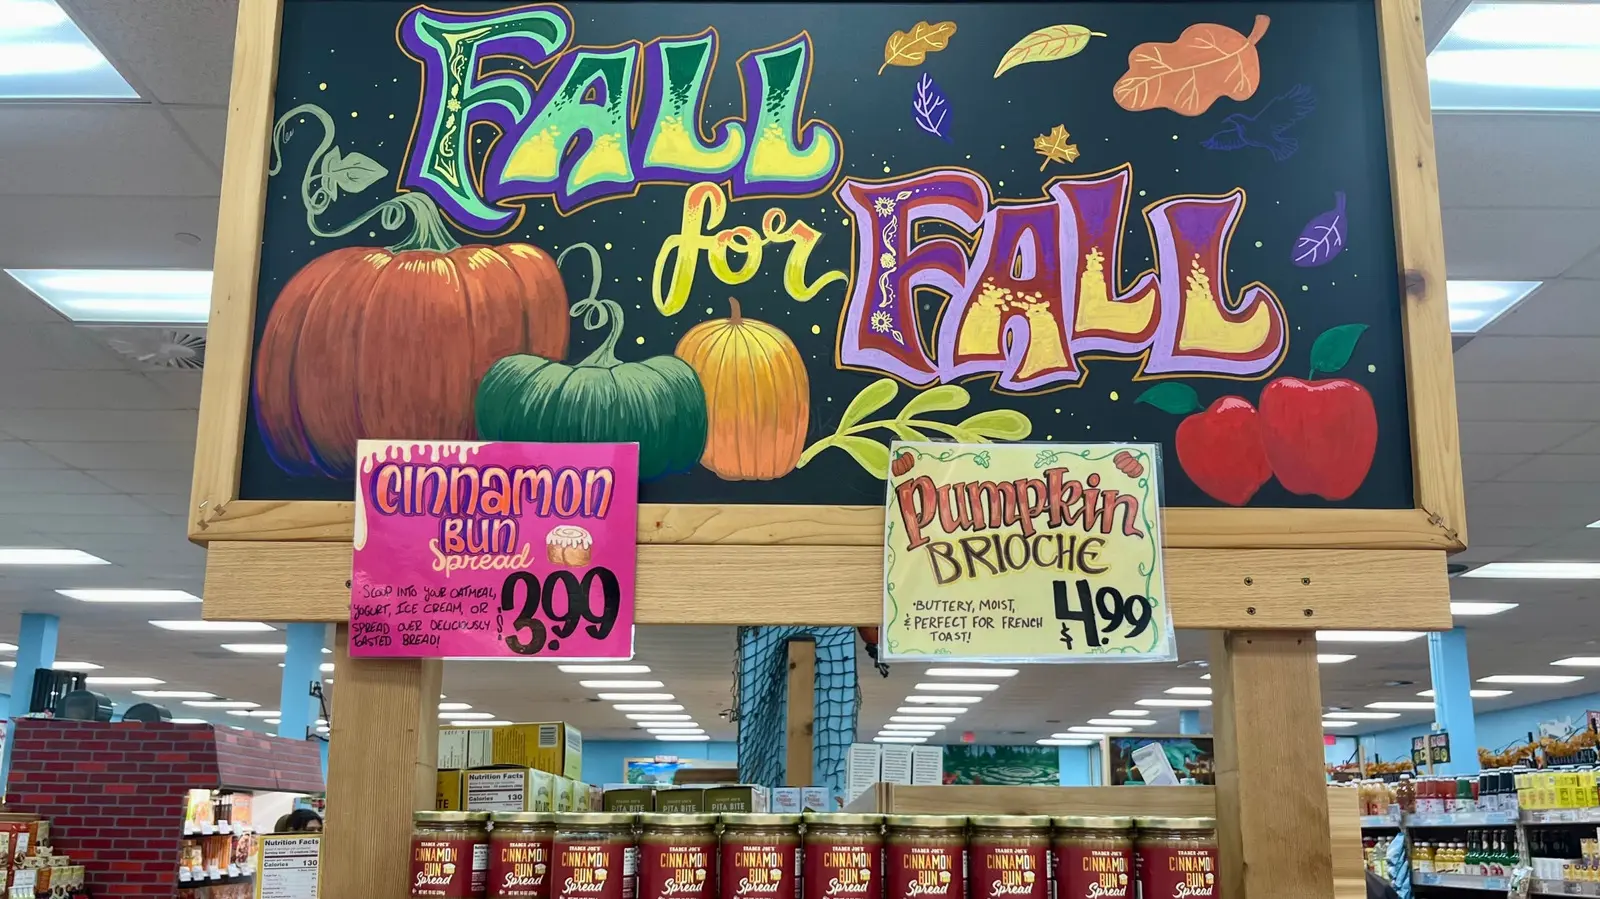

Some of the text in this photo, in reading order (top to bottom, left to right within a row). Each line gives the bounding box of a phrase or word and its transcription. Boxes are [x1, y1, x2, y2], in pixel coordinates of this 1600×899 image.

[400, 4, 842, 234] FALL
[652, 182, 848, 316] for
[835, 164, 1286, 393] FALL
[429, 538, 534, 578] Spread
[925, 533, 1112, 585] BRIOCHE
[397, 585, 417, 598] INTO
[450, 585, 497, 600] OATMEAL,
[353, 601, 489, 620] YOGURT, ICE CREAM, OR
[915, 599, 1015, 613] BUTTERY, MOIST,
[352, 619, 490, 636] SPREAD OVER DELICIOUSLY
[914, 615, 967, 629] PERFECT
[972, 616, 995, 629] FOR
[1002, 616, 1043, 629] FRENCH
[352, 634, 440, 648] TOASTED BREAD!
[930, 631, 972, 643] TOAST!
[629, 804, 645, 812] BITE
[729, 802, 745, 810] BITE
[501, 848, 548, 862] CINNAMON
[561, 852, 609, 867] CINNAMON
[660, 853, 707, 867] CINNAMON
[735, 852, 783, 867] CINNAMON
[824, 852, 872, 867] CINNAMON
[903, 855, 952, 869] CINNAMON
[987, 855, 1036, 870] CINNAMON
[424, 863, 441, 876] BUN
[514, 863, 533, 877] BUN
[1083, 857, 1128, 872] CINNAMON
[1169, 856, 1215, 871] CINNAMON
[414, 871, 453, 887] Spread
[502, 872, 544, 888] Spread
[574, 868, 593, 882] BUN
[675, 868, 694, 883] BUN
[749, 868, 768, 883] BUN
[839, 868, 858, 883] BUN
[919, 870, 938, 885] BUN
[1002, 870, 1022, 885] BUN
[1099, 873, 1118, 888] BUN
[1186, 872, 1204, 887] BUN
[562, 877, 605, 894] Spread
[661, 878, 704, 895] Spread
[736, 877, 780, 895] Spread
[826, 878, 869, 895] Spread
[906, 880, 949, 897] Spread
[990, 879, 1033, 897] Spread
[1086, 882, 1126, 898] Spread
[1172, 881, 1213, 899] Spread
